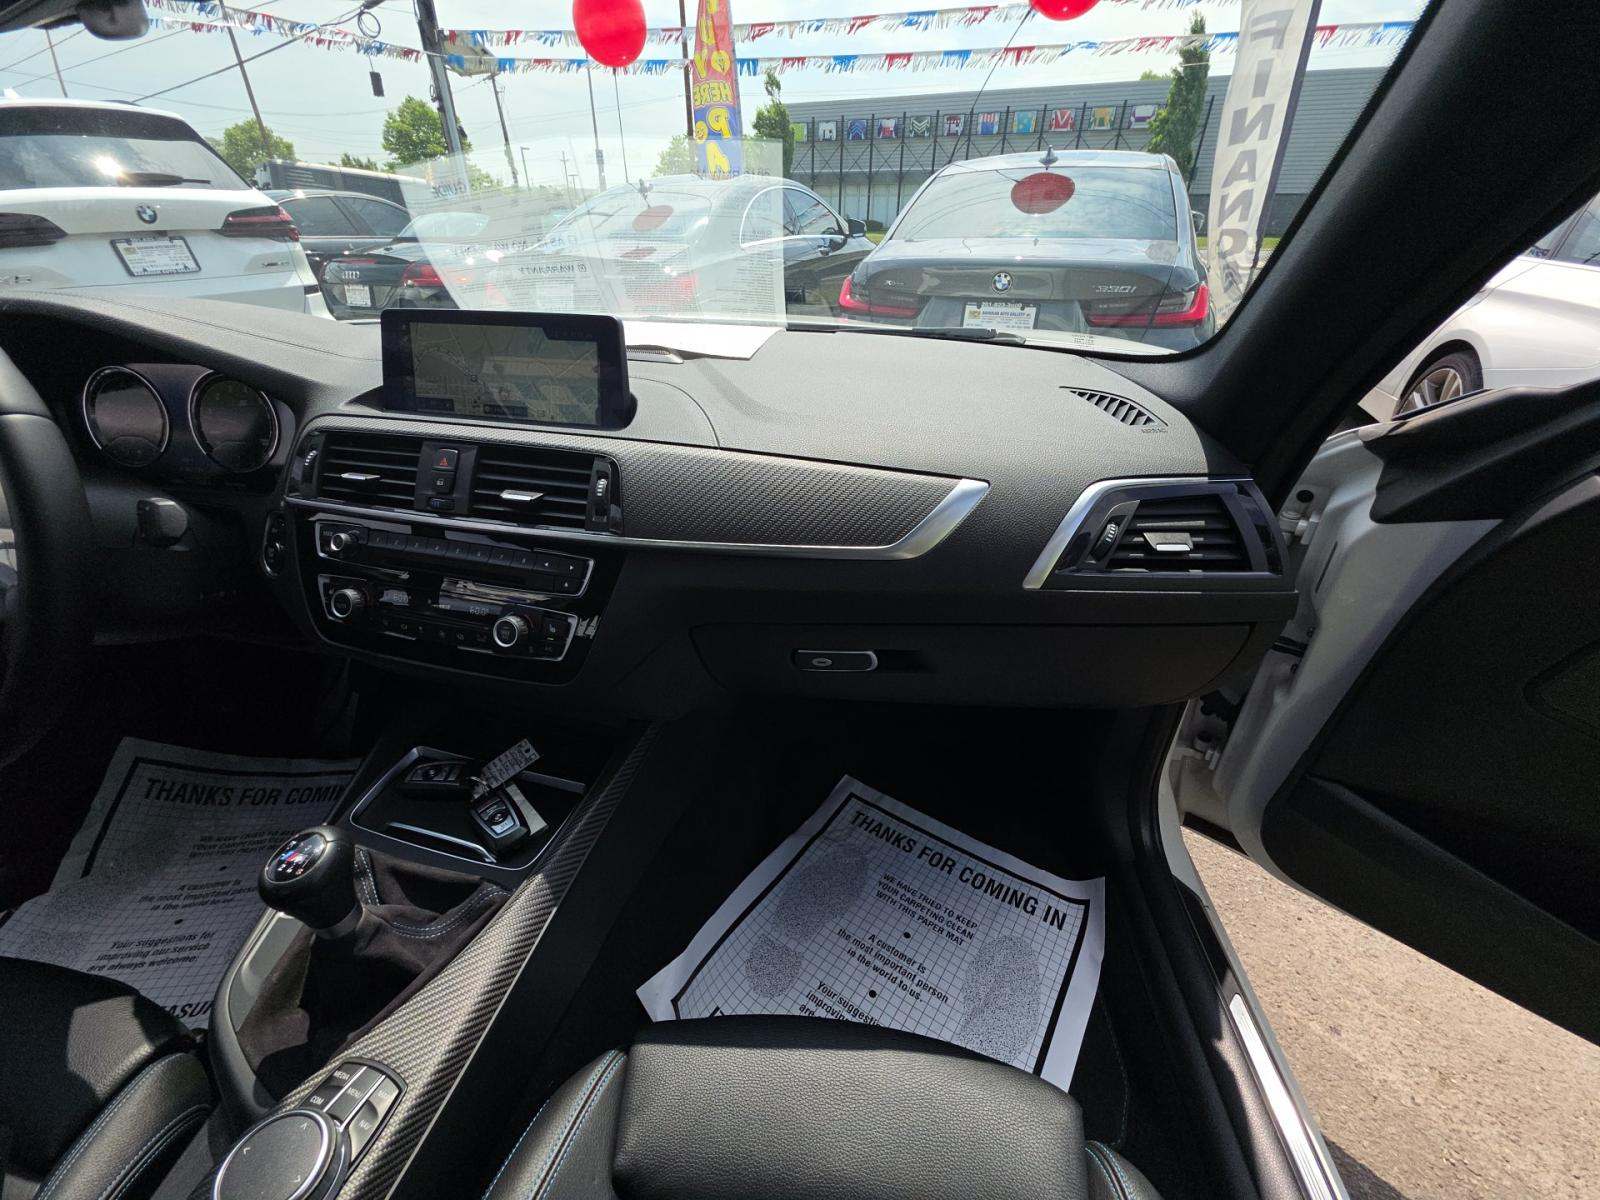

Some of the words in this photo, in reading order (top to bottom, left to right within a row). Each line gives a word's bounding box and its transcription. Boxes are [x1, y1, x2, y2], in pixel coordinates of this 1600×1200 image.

[145, 778, 234, 807] THANKS
[237, 787, 281, 807] FOR
[849, 810, 917, 854] THANKS
[917, 846, 957, 876] FOR
[959, 866, 1039, 916] COMING
[1042, 905, 1067, 931] IN
[875, 889, 897, 906] WITH
[897, 902, 917, 919] THIS
[917, 914, 945, 935] PAPER
[945, 930, 965, 947] MAT
[878, 881, 900, 897] YOUR
[899, 893, 945, 924] CARPETING
[945, 919, 975, 941] CLEAN
[883, 873, 897, 884] WE
[896, 880, 919, 897] HAVE
[918, 893, 942, 911] TRIED
[943, 907, 955, 918] TO
[955, 913, 978, 930] KEEP
[837, 928, 852, 941] the
[851, 938, 874, 956] most
[873, 951, 917, 982] important
[915, 978, 949, 1003] person
[846, 947, 857, 958] in
[856, 953, 872, 968] the
[871, 963, 899, 985] world
[897, 979, 909, 992] to
[908, 987, 923, 1003] us.
[867, 933, 877, 943] A
[876, 940, 917, 967] customer
[916, 962, 927, 975] is
[816, 981, 838, 1000] Your
[309, 1095, 325, 1105] COM
[334, 1070, 351, 1080] MEDIA
